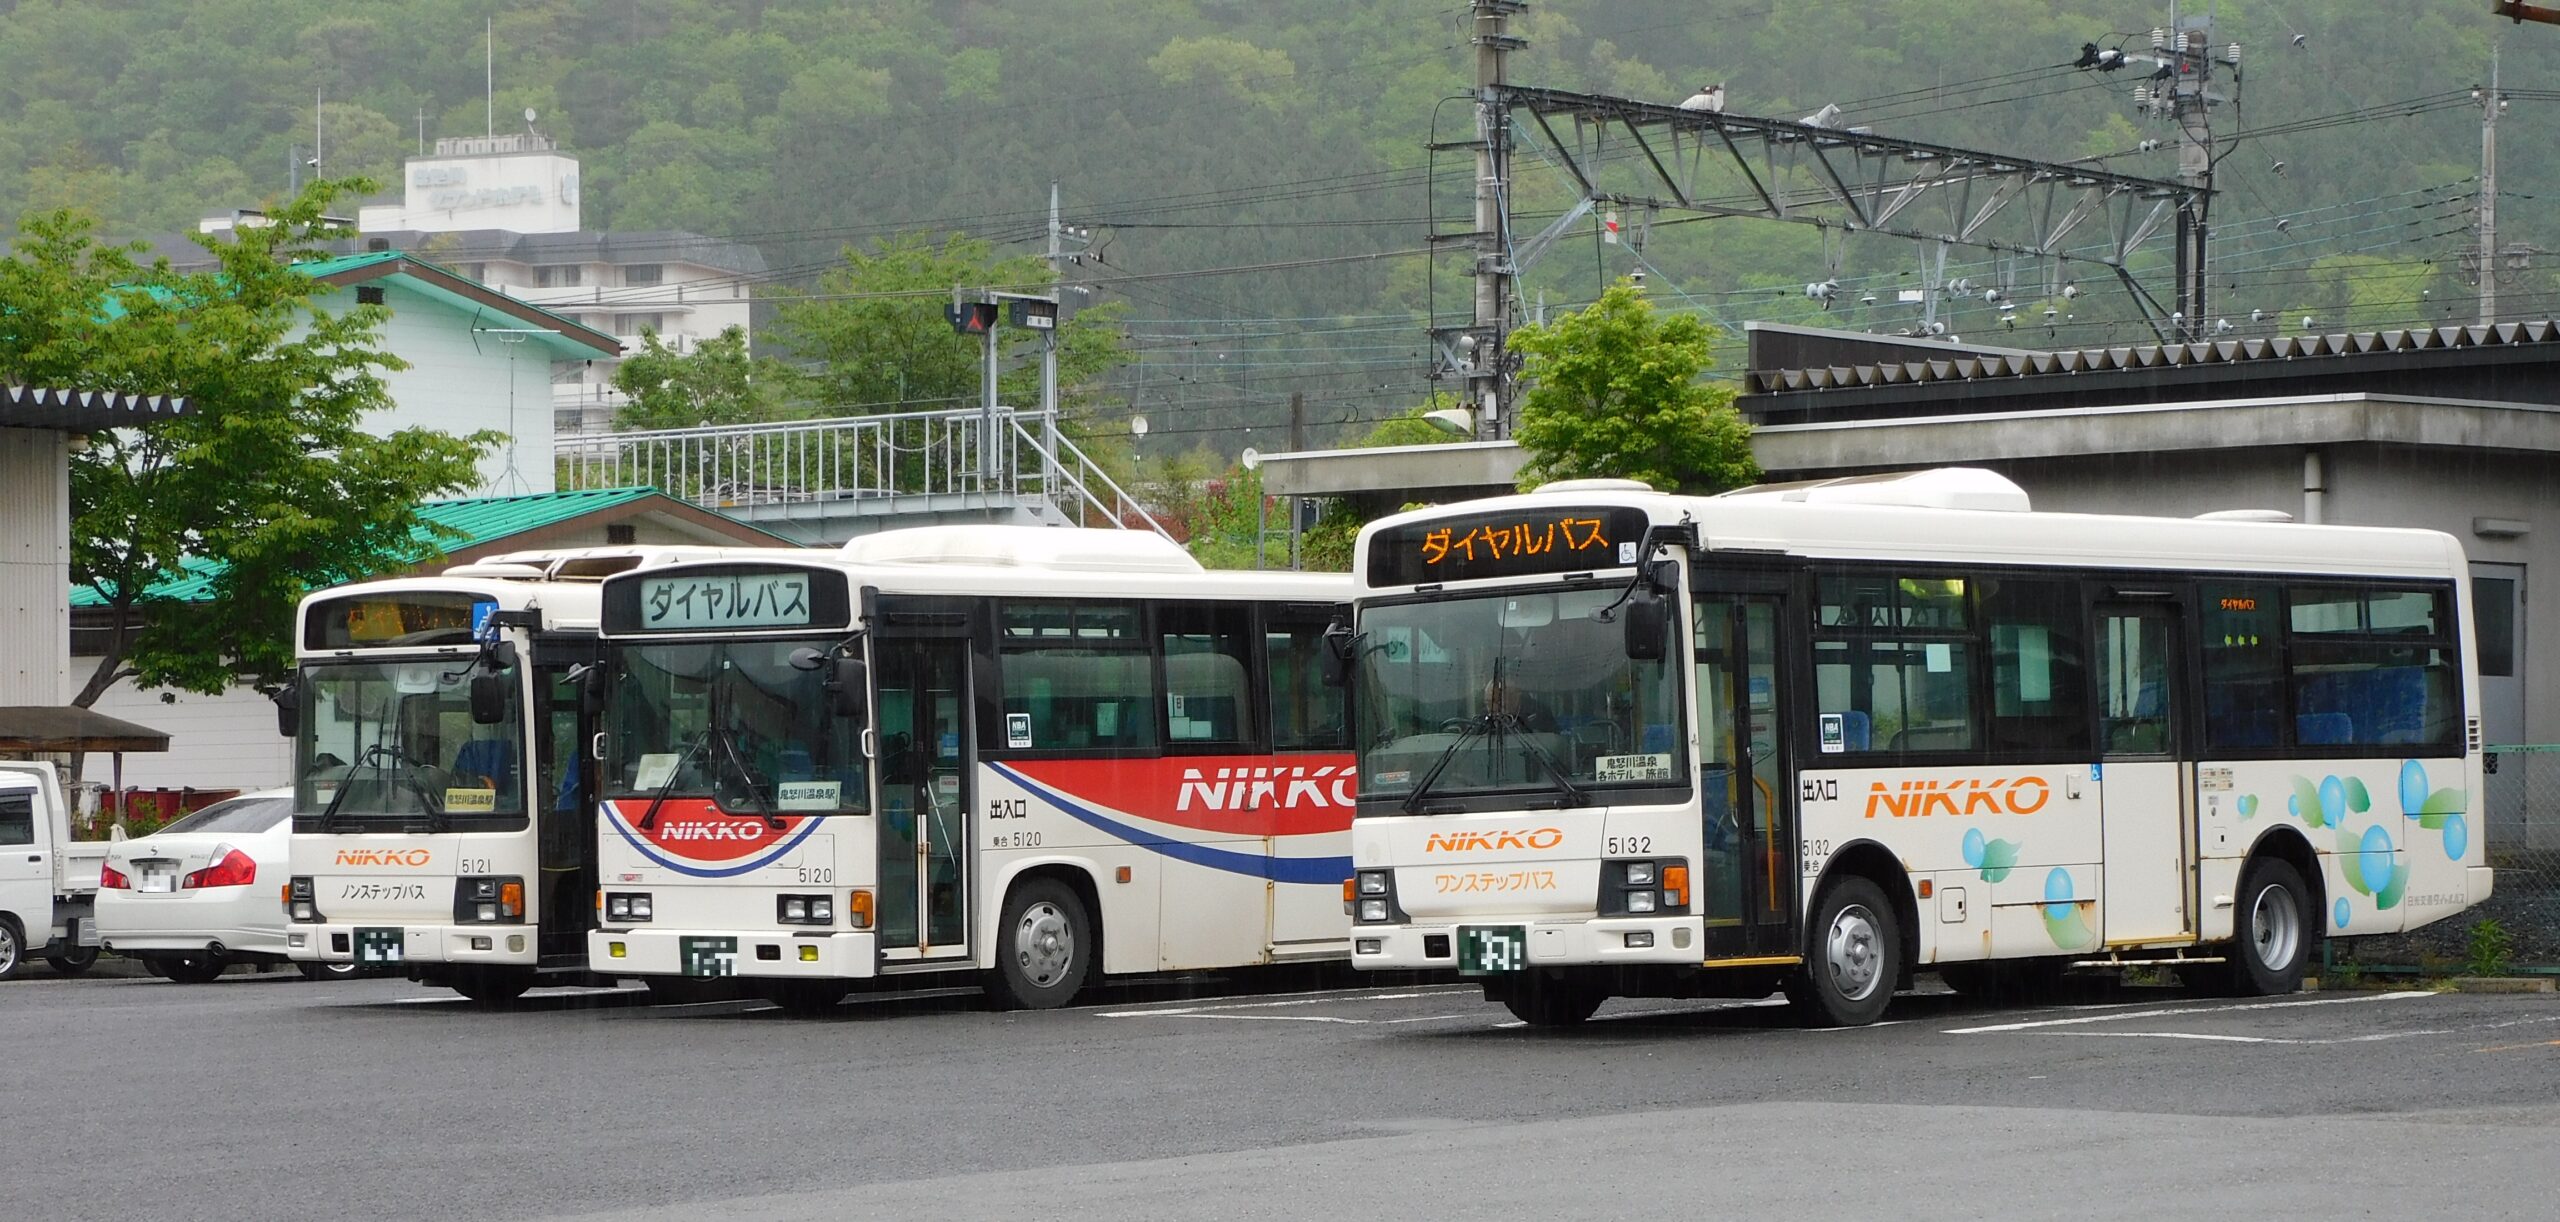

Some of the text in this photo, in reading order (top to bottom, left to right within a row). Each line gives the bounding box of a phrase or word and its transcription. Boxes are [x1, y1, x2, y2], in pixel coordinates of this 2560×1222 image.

[1422, 518, 1609, 565] ダイヤルバス
[650, 577, 807, 621] ダイヤルバス
[1607, 756, 1657, 769] 鬼怒川温泉
[780, 783, 835, 800] 鬼怒川温泉駅
[1803, 779, 1838, 802] 出入口
[1865, 776, 2049, 819] NIKKO
[990, 799, 1026, 819] 出入口
[661, 820, 763, 842] NIKKO
[1013, 831, 1041, 847] 5120
[1426, 828, 1563, 853] NIKKO
[1608, 836, 1652, 855] 5132
[1803, 839, 1829, 857] 5132
[335, 849, 431, 867] NIKKO
[462, 858, 491, 874] 5121
[798, 868, 832, 884] 5120
[1435, 870, 1556, 894] ワンステップバス
[341, 884, 425, 901] ノンステップバス
